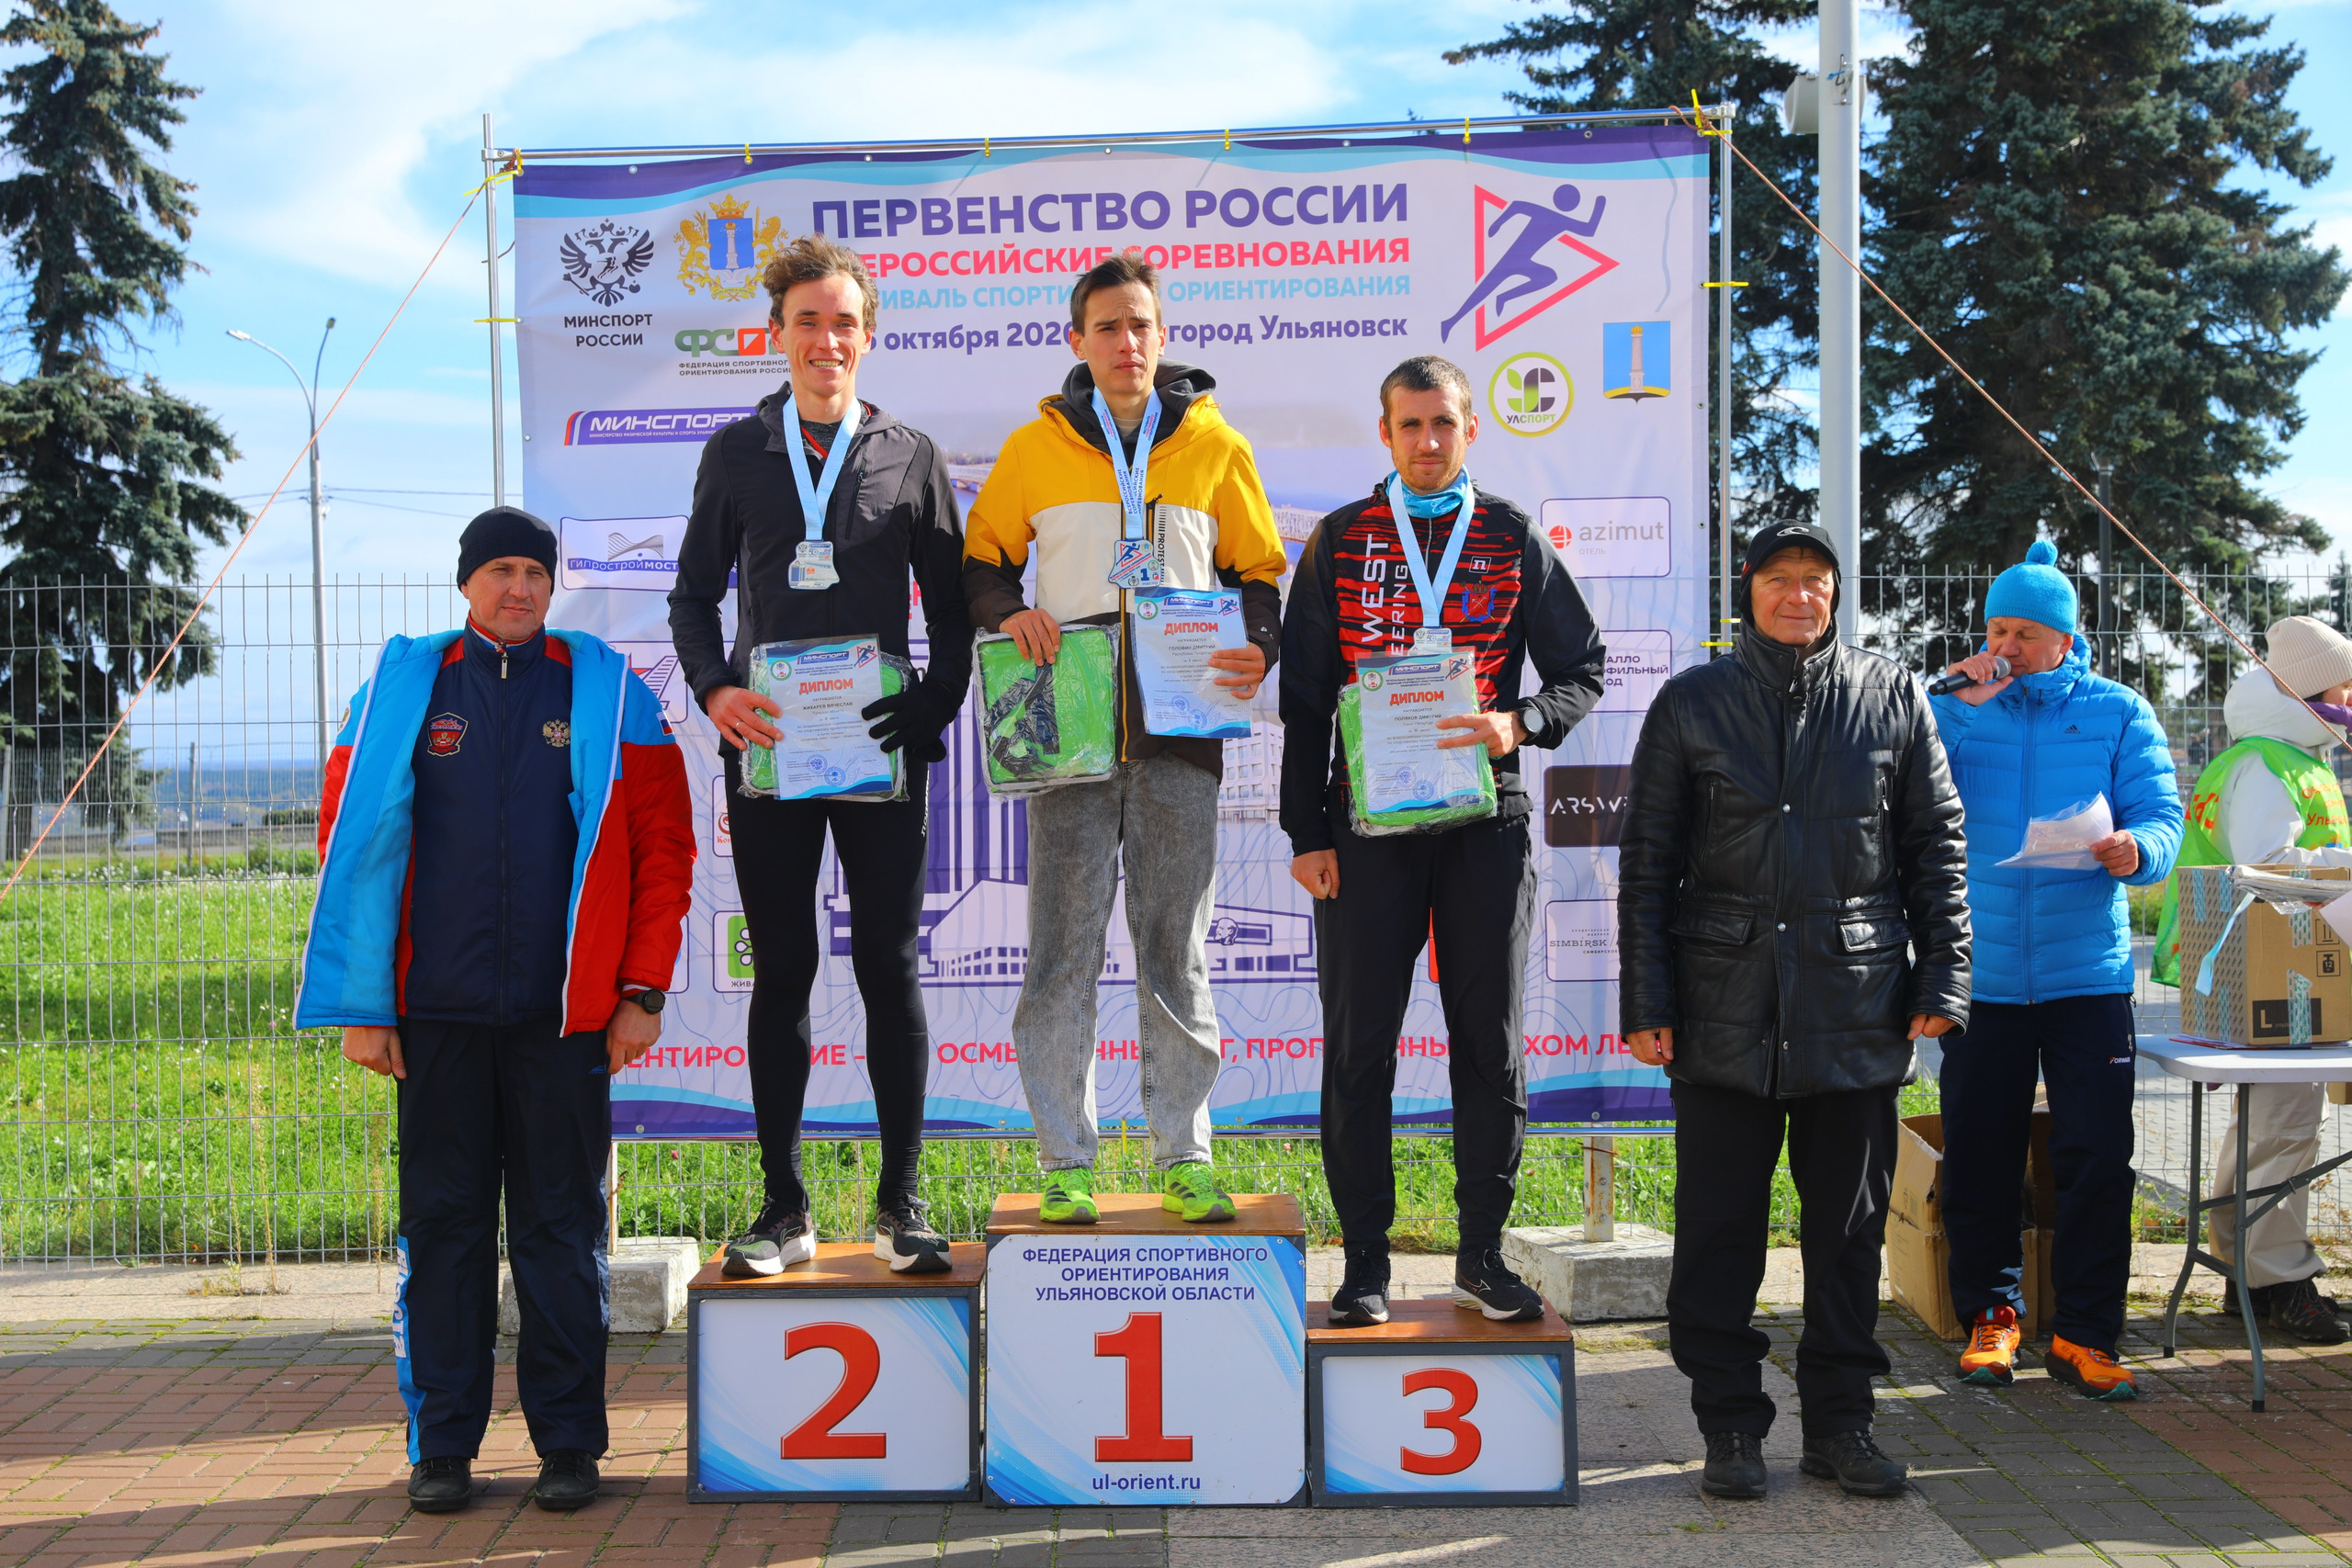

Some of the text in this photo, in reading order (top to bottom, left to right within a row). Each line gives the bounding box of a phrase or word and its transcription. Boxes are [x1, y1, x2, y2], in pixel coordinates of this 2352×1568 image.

[812, 184, 1408, 239] ПЕРВЕНСТВО РОССИИ
[861, 243, 1113, 277] ЕРОССИЙСКИЕ
[1168, 276, 1410, 302] ОРИЕНТИРОВАНИЯ
[564, 314, 652, 329] МИНСПОРТ
[576, 333, 643, 347] РОССИИ
[884, 323, 1000, 355] октября
[1170, 321, 1252, 348] город
[1259, 315, 1408, 340] Ульяновск
[679, 361, 729, 369] ФЕДЕРАЦИЯ
[590, 412, 751, 431] МИНСПОРТ
[1507, 414, 1555, 423] УЛСПОРТ
[1579, 522, 1664, 541] azimut
[1140, 568, 1149, 581] 1
[1362, 534, 1388, 642] WEST
[1391, 565, 1408, 655] EERING
[1164, 622, 1218, 636] ДИПЛОМ
[1605, 664, 1668, 674] ФИЛЬНЫЙ
[799, 678, 854, 695] ДИПЛОМ
[1390, 690, 1444, 706] ДИПЛОМ
[2261, 1010, 2272, 1028] L
[1022, 1247, 1268, 1264] ФЕДЕРАЦИЯ СПОРТИВНОГО
[1061, 1267, 1229, 1281] ОРИЕНТИРОВАНИЯ
[1035, 1284, 1255, 1302] УЛЬЯНОВСКОЙ ОБЛАСТИ
[779, 1321, 888, 1461] 2
[1094, 1312, 1193, 1462] 1
[1399, 1367, 1483, 1475] 3
[1091, 1473, 1201, 1490] ul-orient.ru
